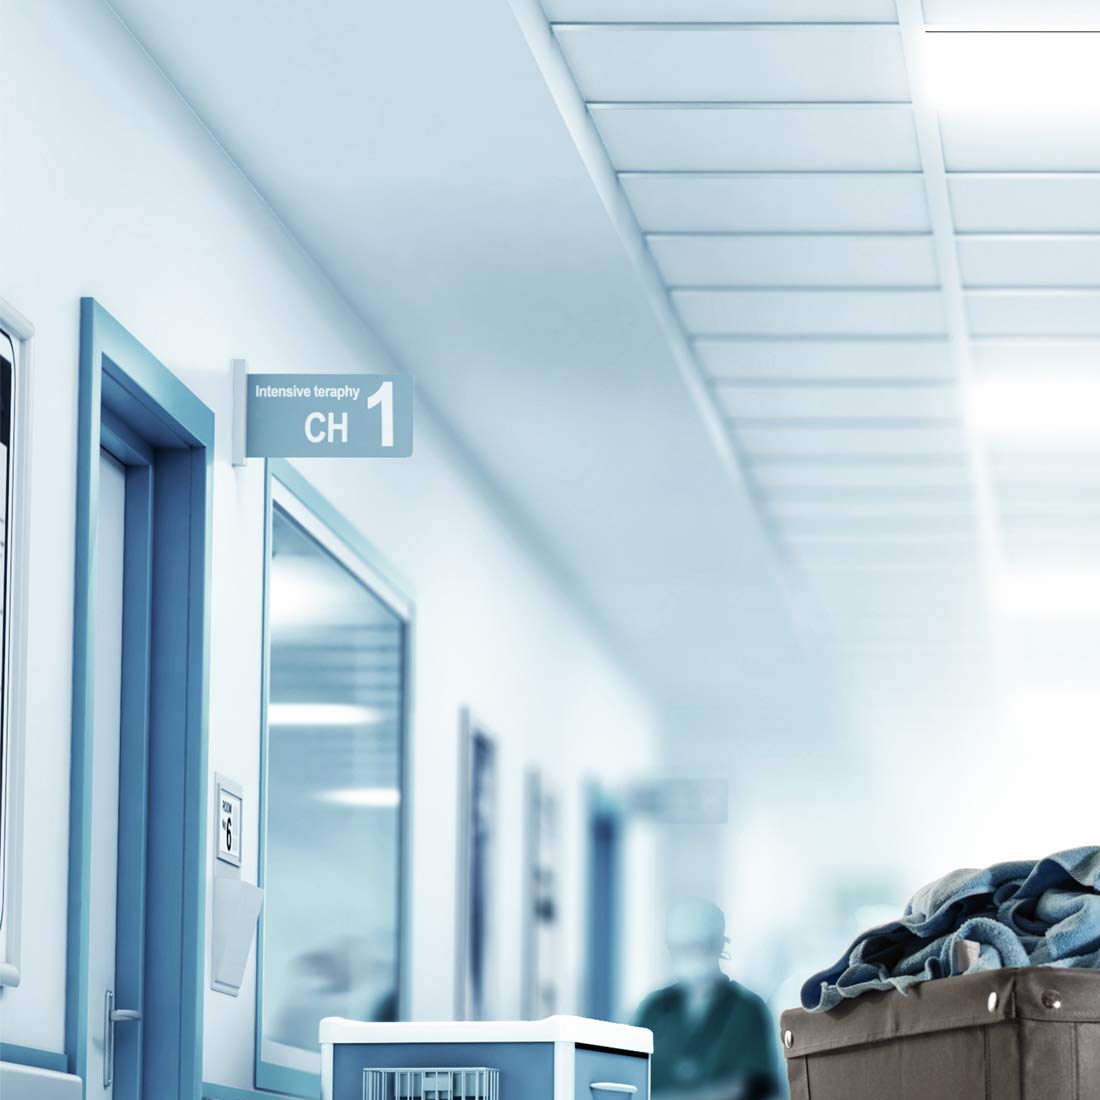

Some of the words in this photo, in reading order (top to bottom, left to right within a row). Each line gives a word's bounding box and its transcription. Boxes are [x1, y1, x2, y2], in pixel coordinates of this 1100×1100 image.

[255, 385, 311, 398] Intensive
[313, 385, 360, 401] teraphy
[304, 411, 348, 443] CH
[367, 381, 394, 447] 1
[226, 817, 232, 851] 6
